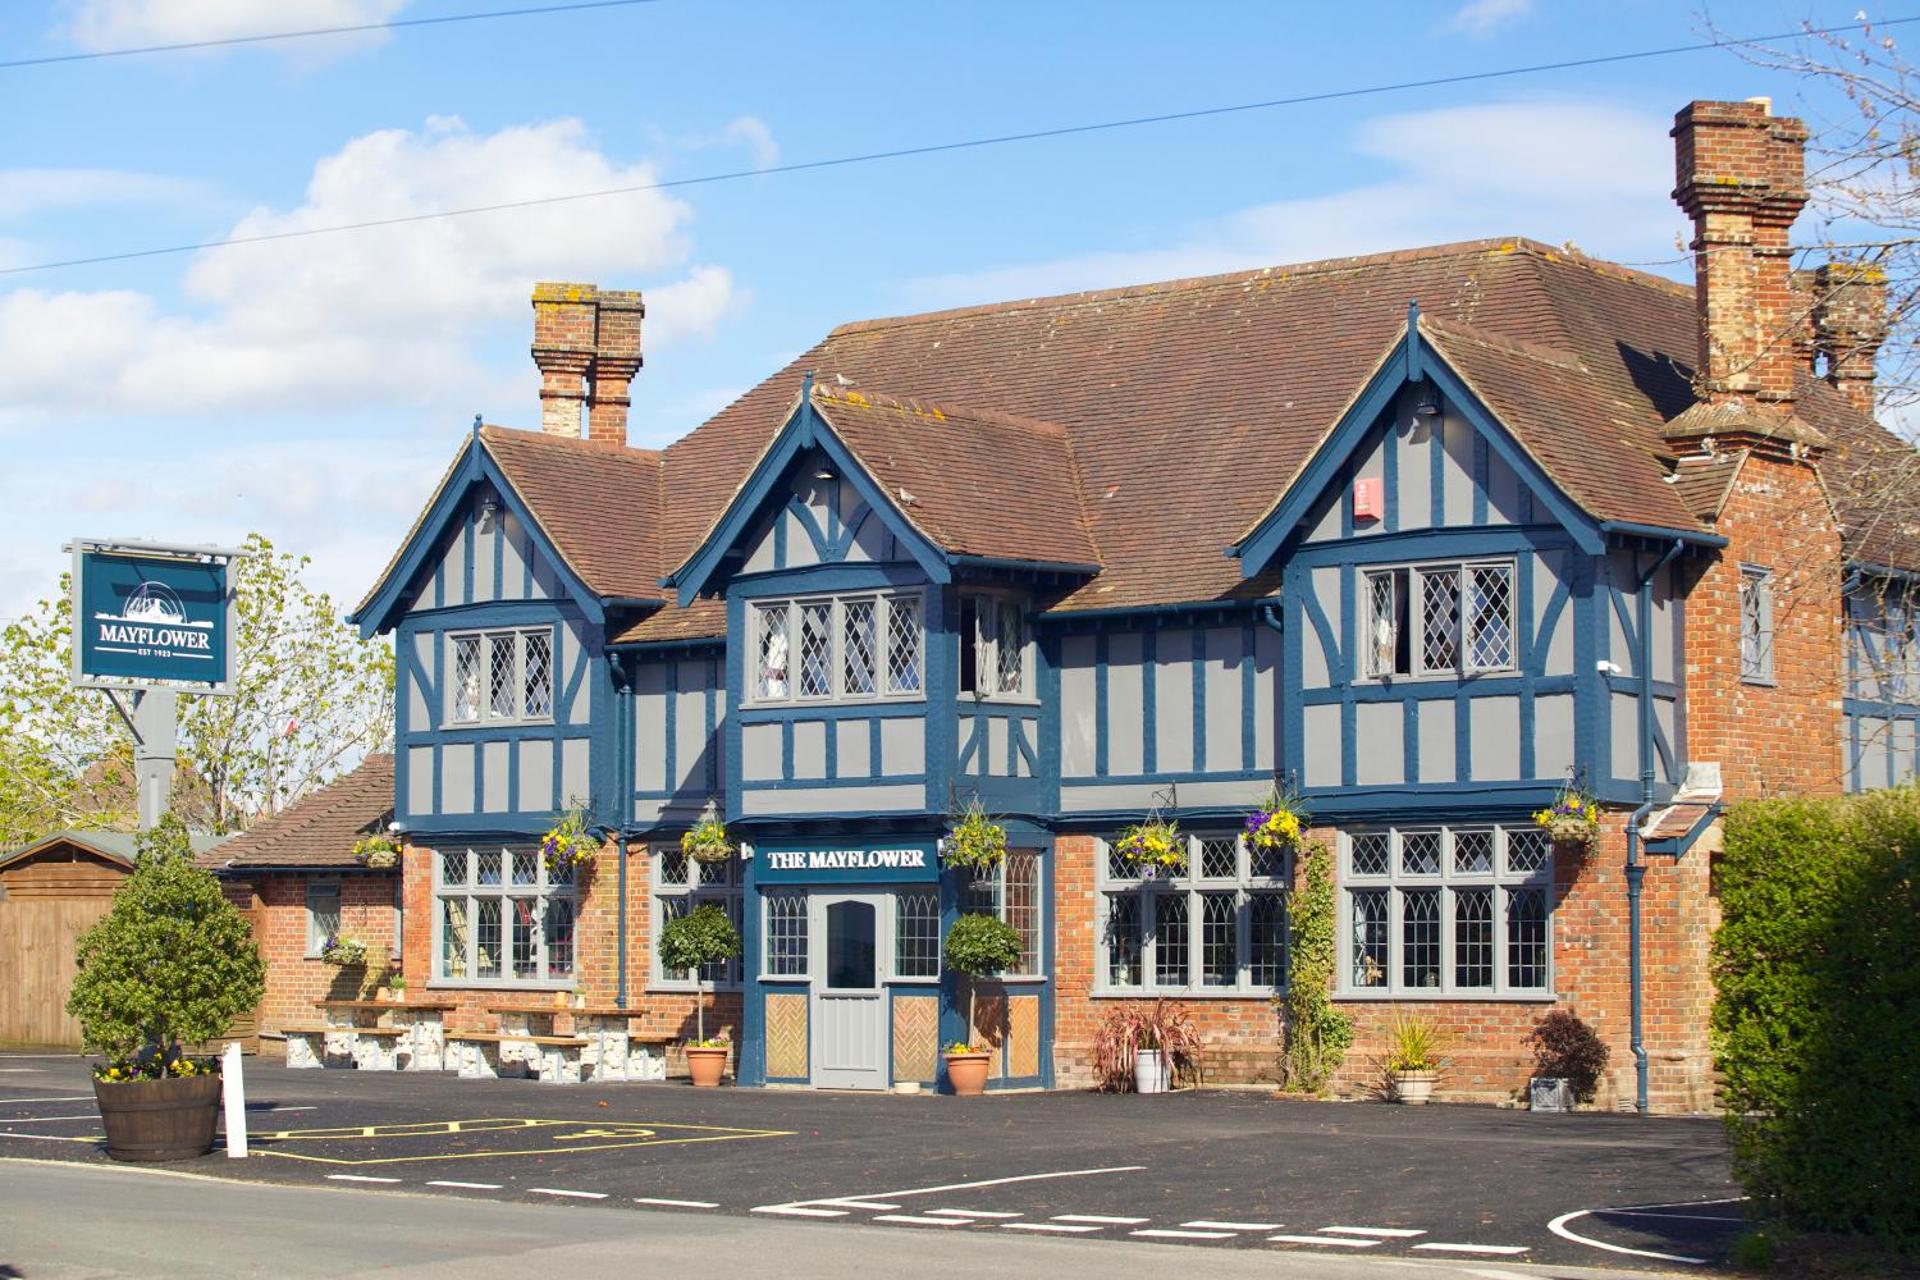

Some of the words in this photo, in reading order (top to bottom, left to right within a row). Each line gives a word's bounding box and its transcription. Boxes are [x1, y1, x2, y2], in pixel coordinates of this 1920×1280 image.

[100, 624, 210, 650] MAYFLOWER
[767, 852, 806, 869] THE
[808, 849, 926, 868] MAYFLOWER
